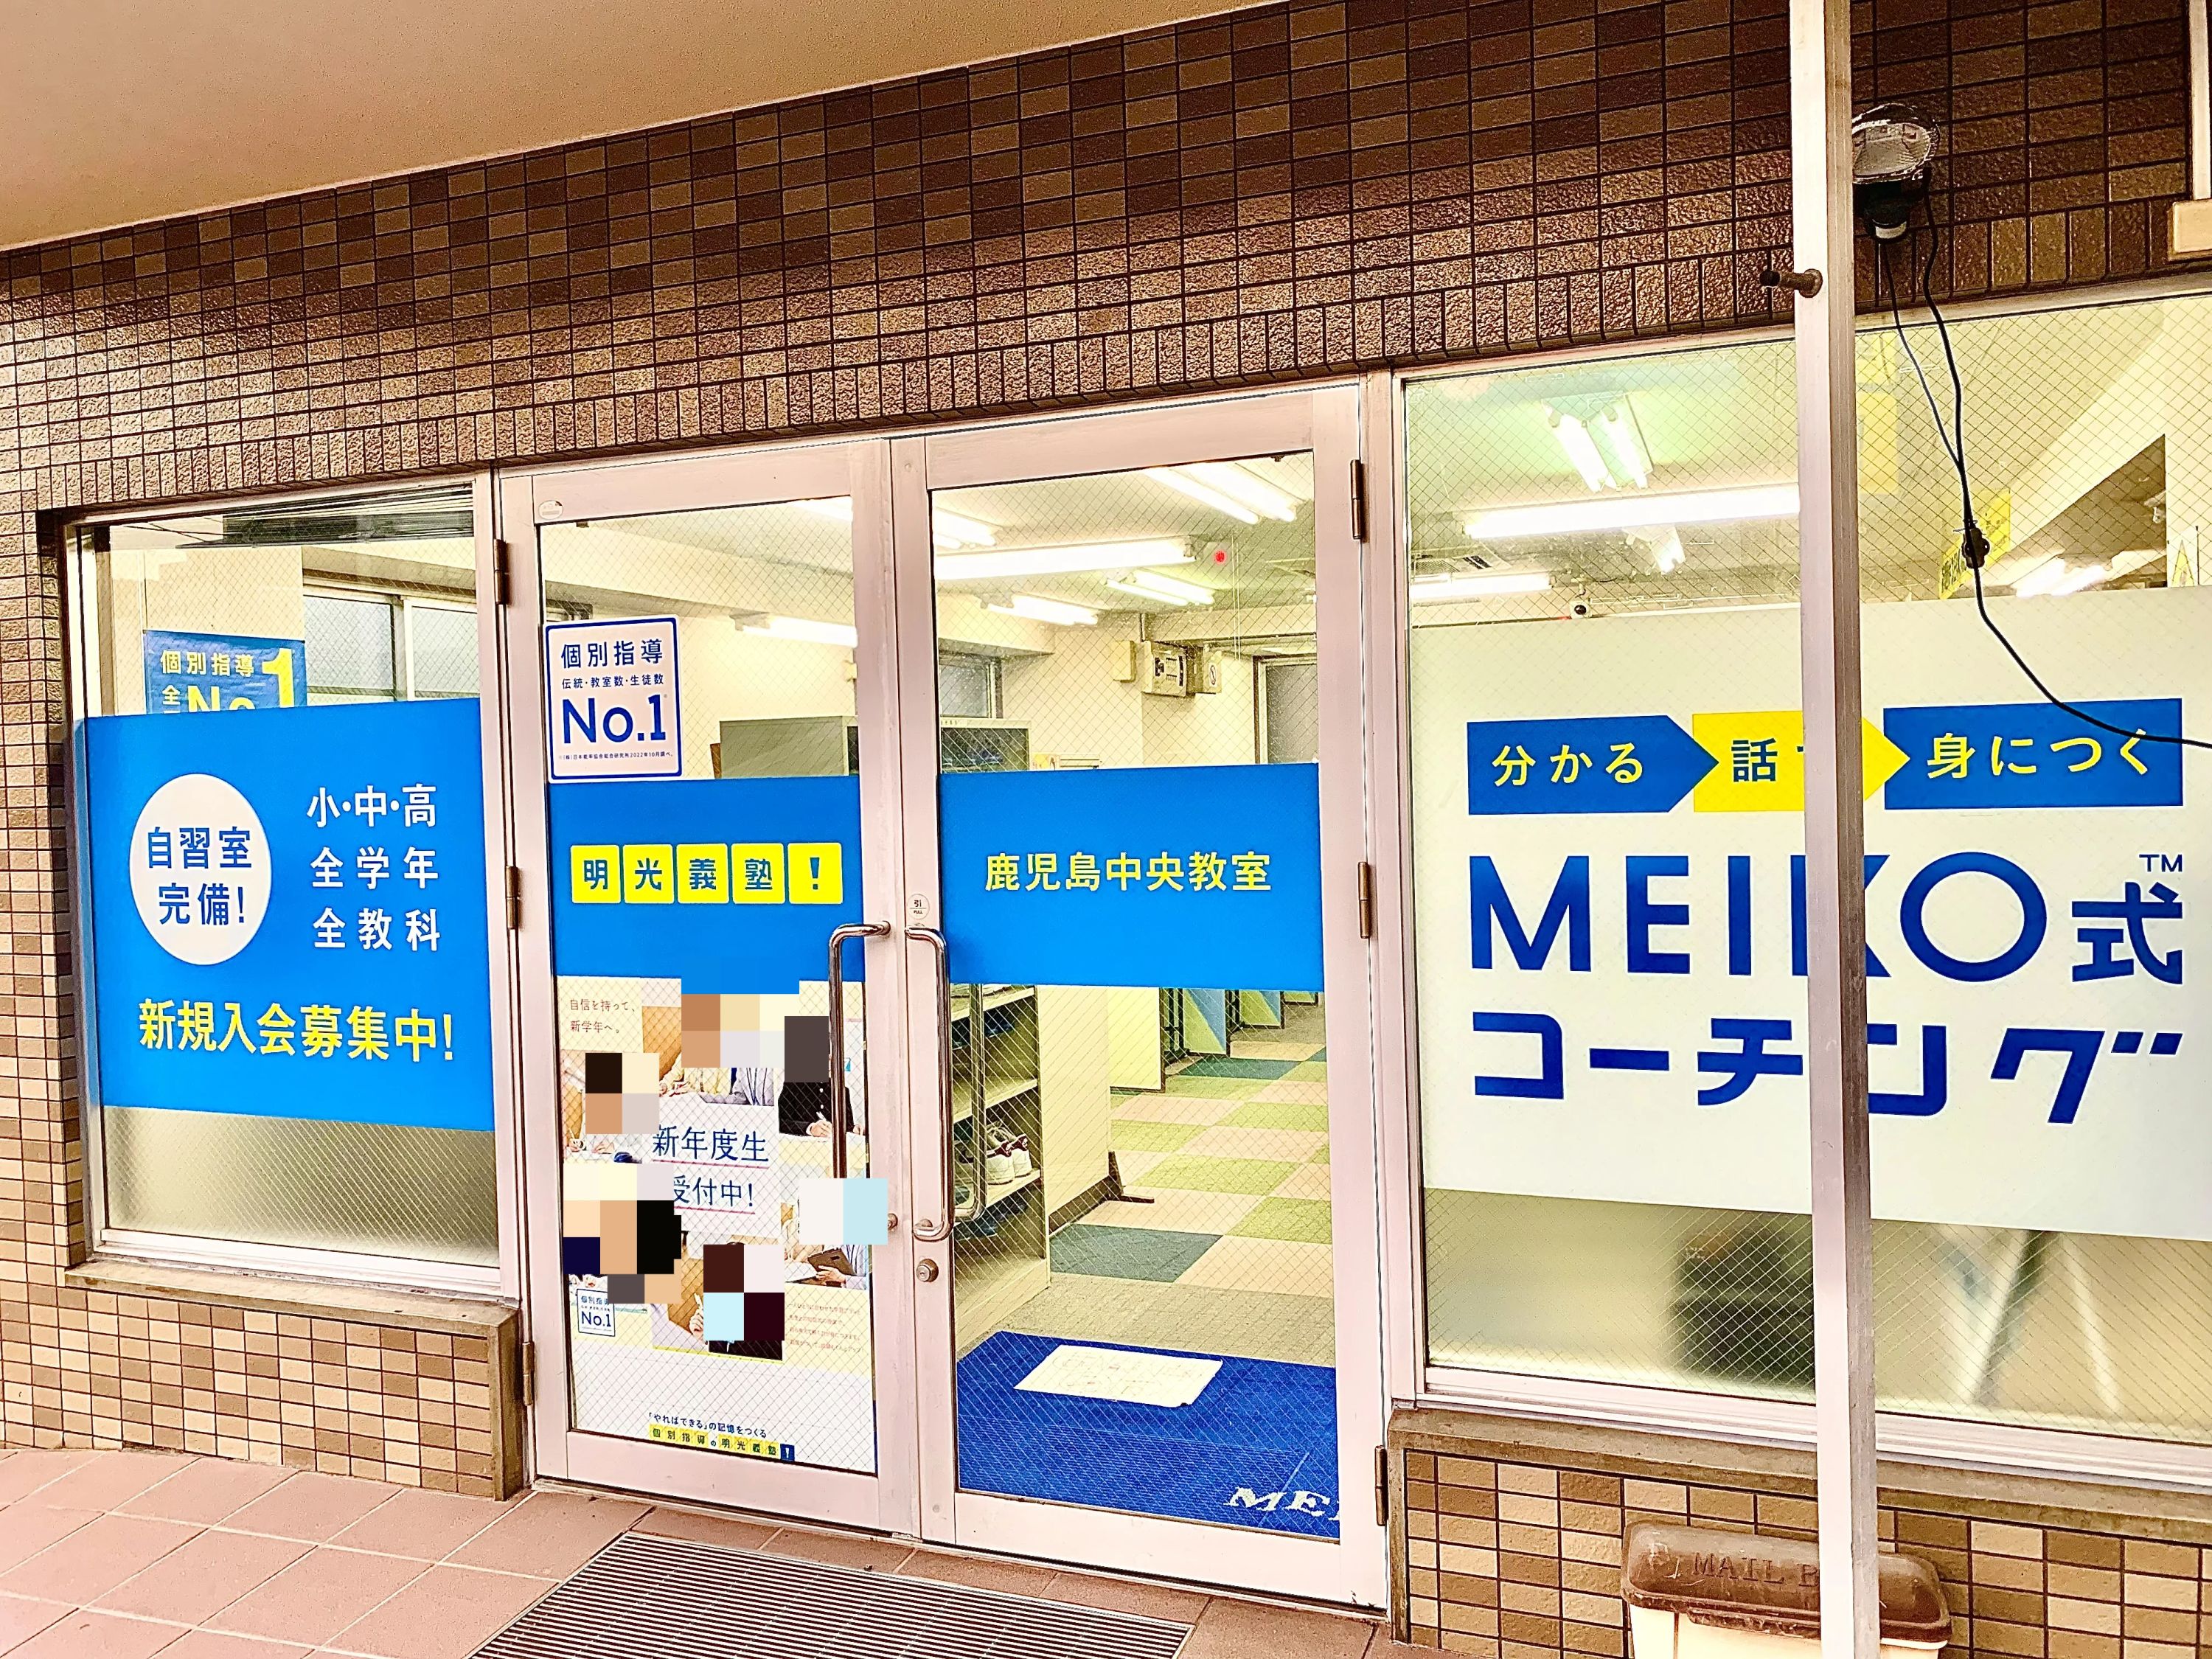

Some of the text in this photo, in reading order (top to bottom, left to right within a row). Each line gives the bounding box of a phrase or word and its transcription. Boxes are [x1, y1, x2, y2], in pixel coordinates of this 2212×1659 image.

[160, 650, 254, 677] 個別指導
[560, 639, 662, 669] 個別指導
[562, 673, 664, 689] 伝統・教室数・生徒数
[562, 694, 666, 744] No.1
[1492, 742, 1644, 787] 分かる
[1731, 738, 1805, 783] 話
[1927, 728, 2149, 779] 身につく
[306, 783, 437, 828] 小・中・高
[147, 826, 252, 870] 自習室
[310, 845, 439, 891] 全学年
[582, 856, 821, 891] 明光義塾!
[984, 851, 1272, 892] 鹿児島中央教室
[158, 883, 246, 927] 完備!
[914, 899, 922, 908] 引
[313, 908, 442, 953] 全教科
[570, 998, 635, 1012] 自信を持って、
[138, 998, 454, 1062] 新規入会募集中!
[570, 1020, 619, 1033] 新学年へ。
[1472, 1011, 2184, 1124] コーチング
[653, 1124, 769, 1162] 新年度生
[674, 1175, 754, 1207] 受付中!
[581, 1310, 611, 1327] No.1
[649, 1412, 767, 1439] 「やればできる」の記憶をつくる
[1223, 1486, 1340, 1521] ME
[1693, 1551, 1785, 1585] MAIL
